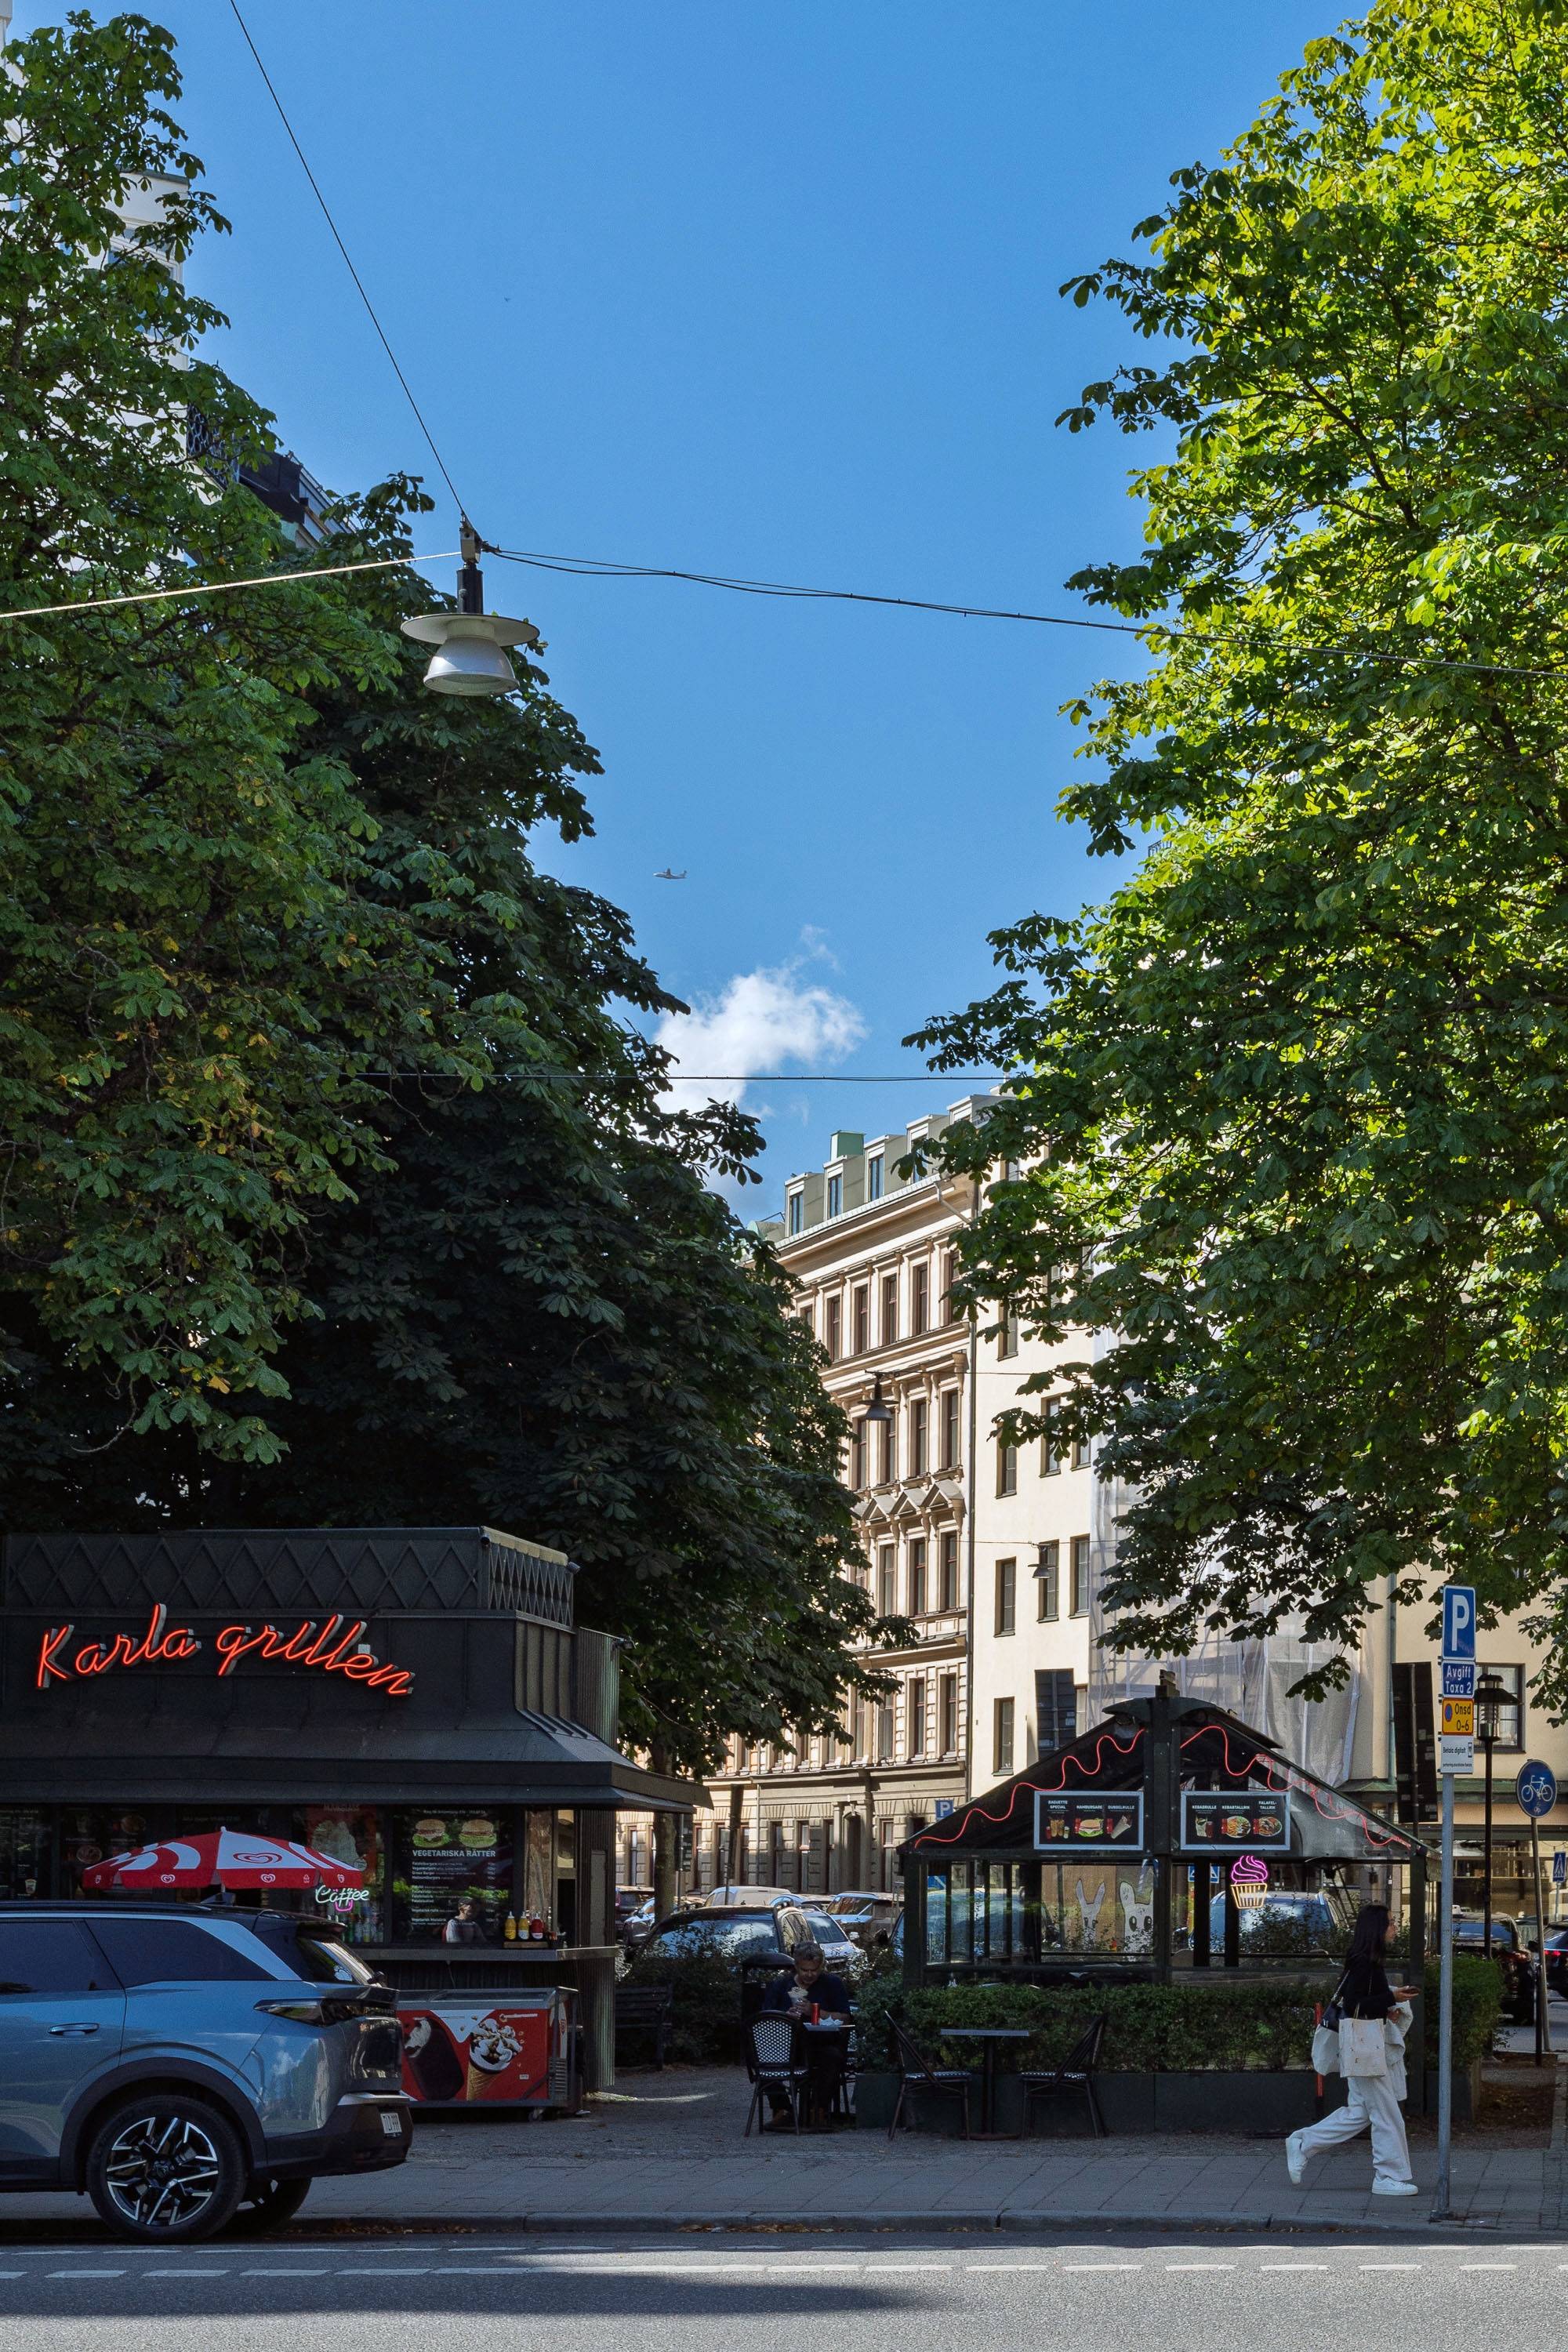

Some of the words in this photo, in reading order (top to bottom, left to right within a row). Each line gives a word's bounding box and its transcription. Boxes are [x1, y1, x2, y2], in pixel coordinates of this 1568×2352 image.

[1452, 1594, 1470, 1651] P
[37, 1603, 199, 1688] Karla
[216, 1613, 411, 1695] grillen
[1446, 1664, 1471, 1681] Avgift
[1446, 1681, 1464, 1693] Taxa
[1467, 1682, 1472, 1693] 2
[1454, 1703, 1472, 1715] Onsd
[1456, 1719, 1470, 1731] 0-6
[939, 1802, 951, 1817] P
[466, 1848, 496, 1857] RÄTTER
[315, 1885, 370, 1907] Coffee
